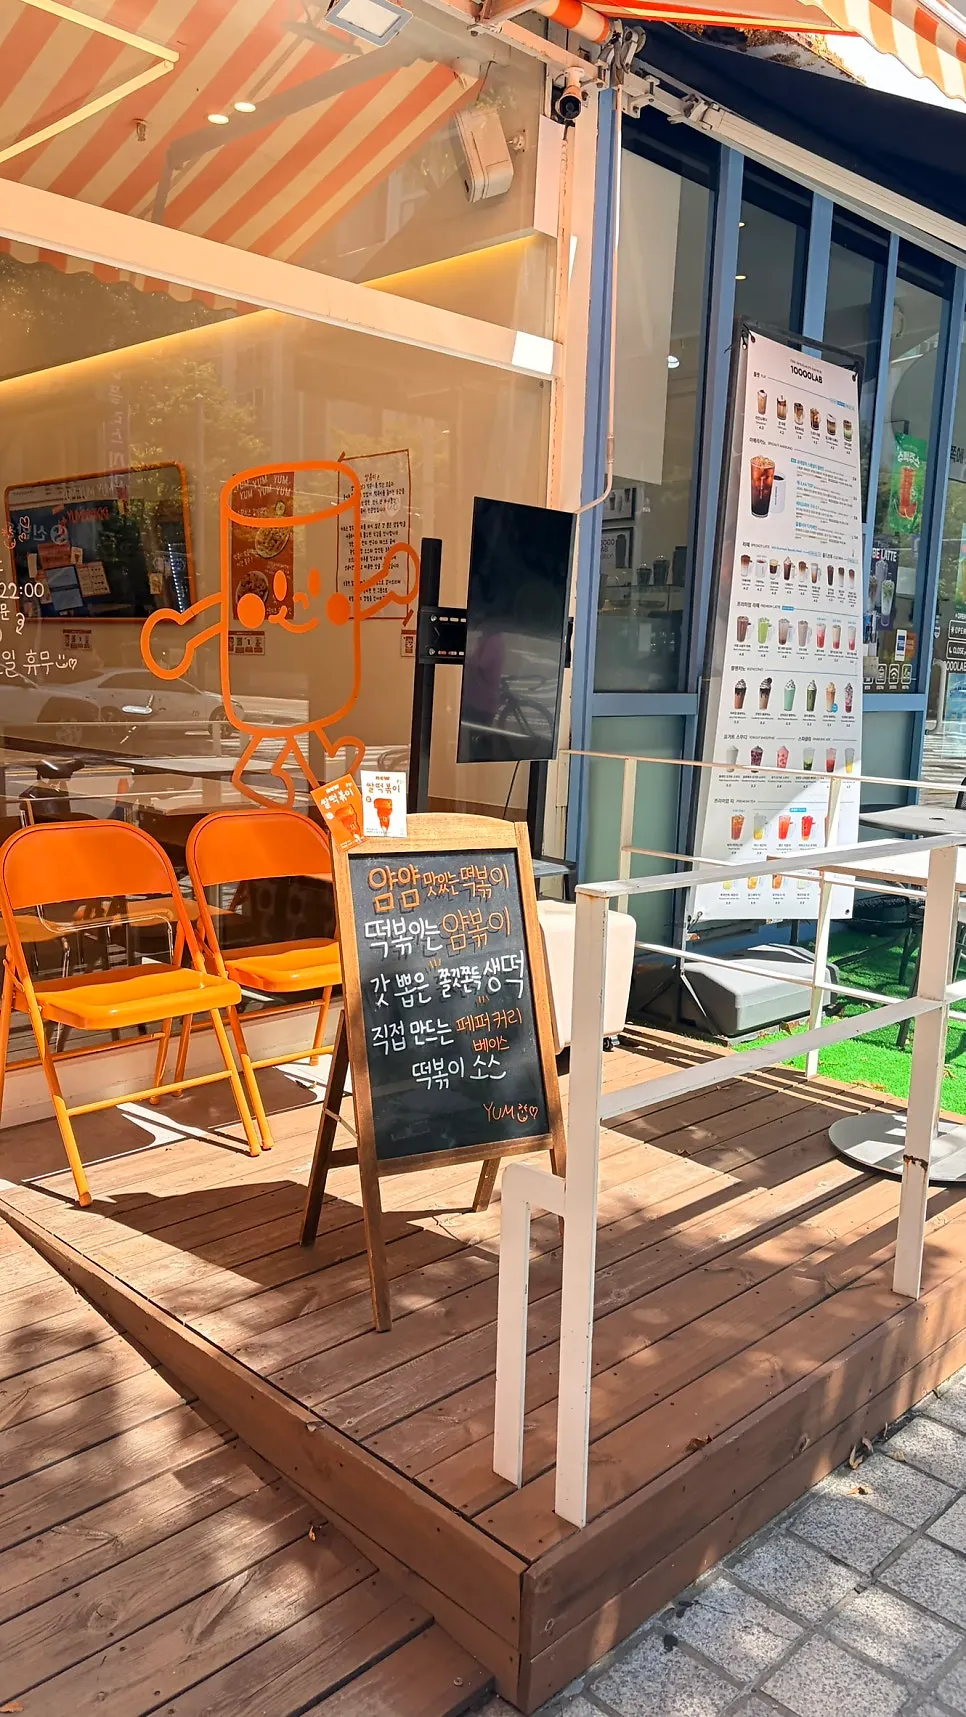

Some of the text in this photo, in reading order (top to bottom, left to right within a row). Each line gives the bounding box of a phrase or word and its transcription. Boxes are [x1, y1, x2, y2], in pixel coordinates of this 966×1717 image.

[791, 365, 822, 383] 10000LAB
[274, 474, 289, 485] YUM
[239, 485, 291, 500] YUM YUM YUM
[881, 548, 897, 562] LATTE
[0, 582, 44, 599] 22:00
[23, 649, 54, 676] 휴무
[368, 863, 509, 913] 얌얌 맛있는 떡볶이
[364, 905, 511, 958] 떡볶이는 얌볶이
[370, 973, 391, 1006] 갓
[394, 972, 432, 1008] 뽑은
[483, 949, 525, 999] 생떡
[371, 1020, 407, 1056] 직접
[409, 1018, 454, 1046] 만드는
[472, 1035, 510, 1053] 베이스
[412, 1054, 507, 1090] 떡볶이 소스
[483, 1101, 515, 1122] YUM
